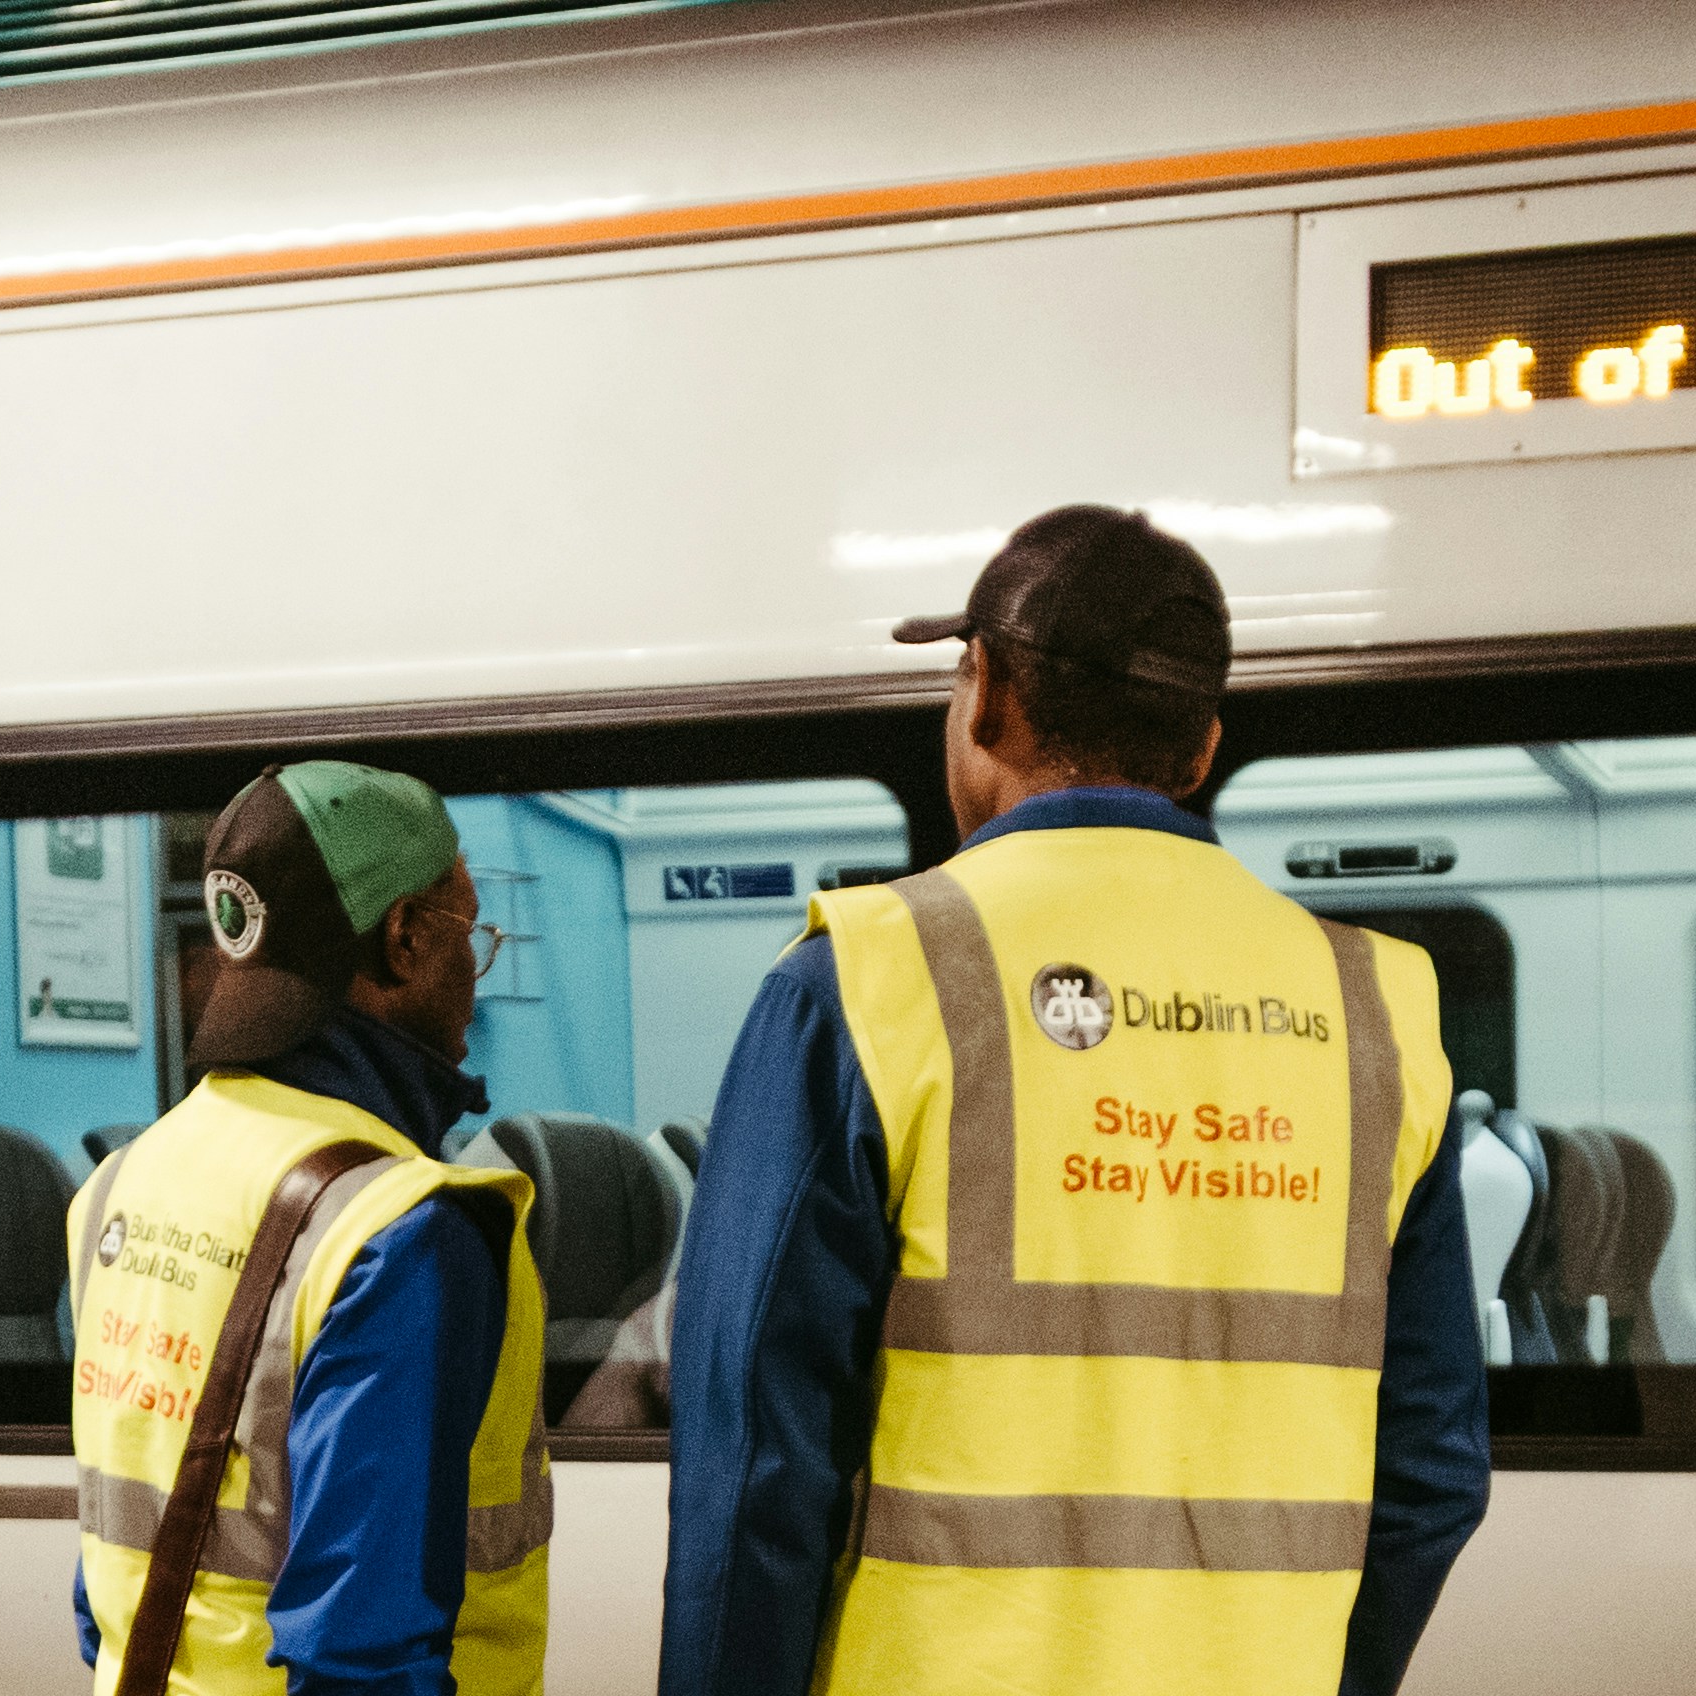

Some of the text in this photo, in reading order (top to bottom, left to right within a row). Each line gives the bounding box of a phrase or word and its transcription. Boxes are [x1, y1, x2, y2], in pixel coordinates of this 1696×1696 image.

[1373, 337, 1535, 417] Out
[1578, 322, 1685, 403] of
[1121, 985, 1330, 1044] Dublin Bus
[1093, 1095, 1295, 1150] Stay Safe
[1061, 1152, 1321, 1204] Stay Visible!
[128, 1213, 157, 1243] Bus
[194, 1232, 248, 1274] Cliat
[160, 1257, 198, 1292] Bus
